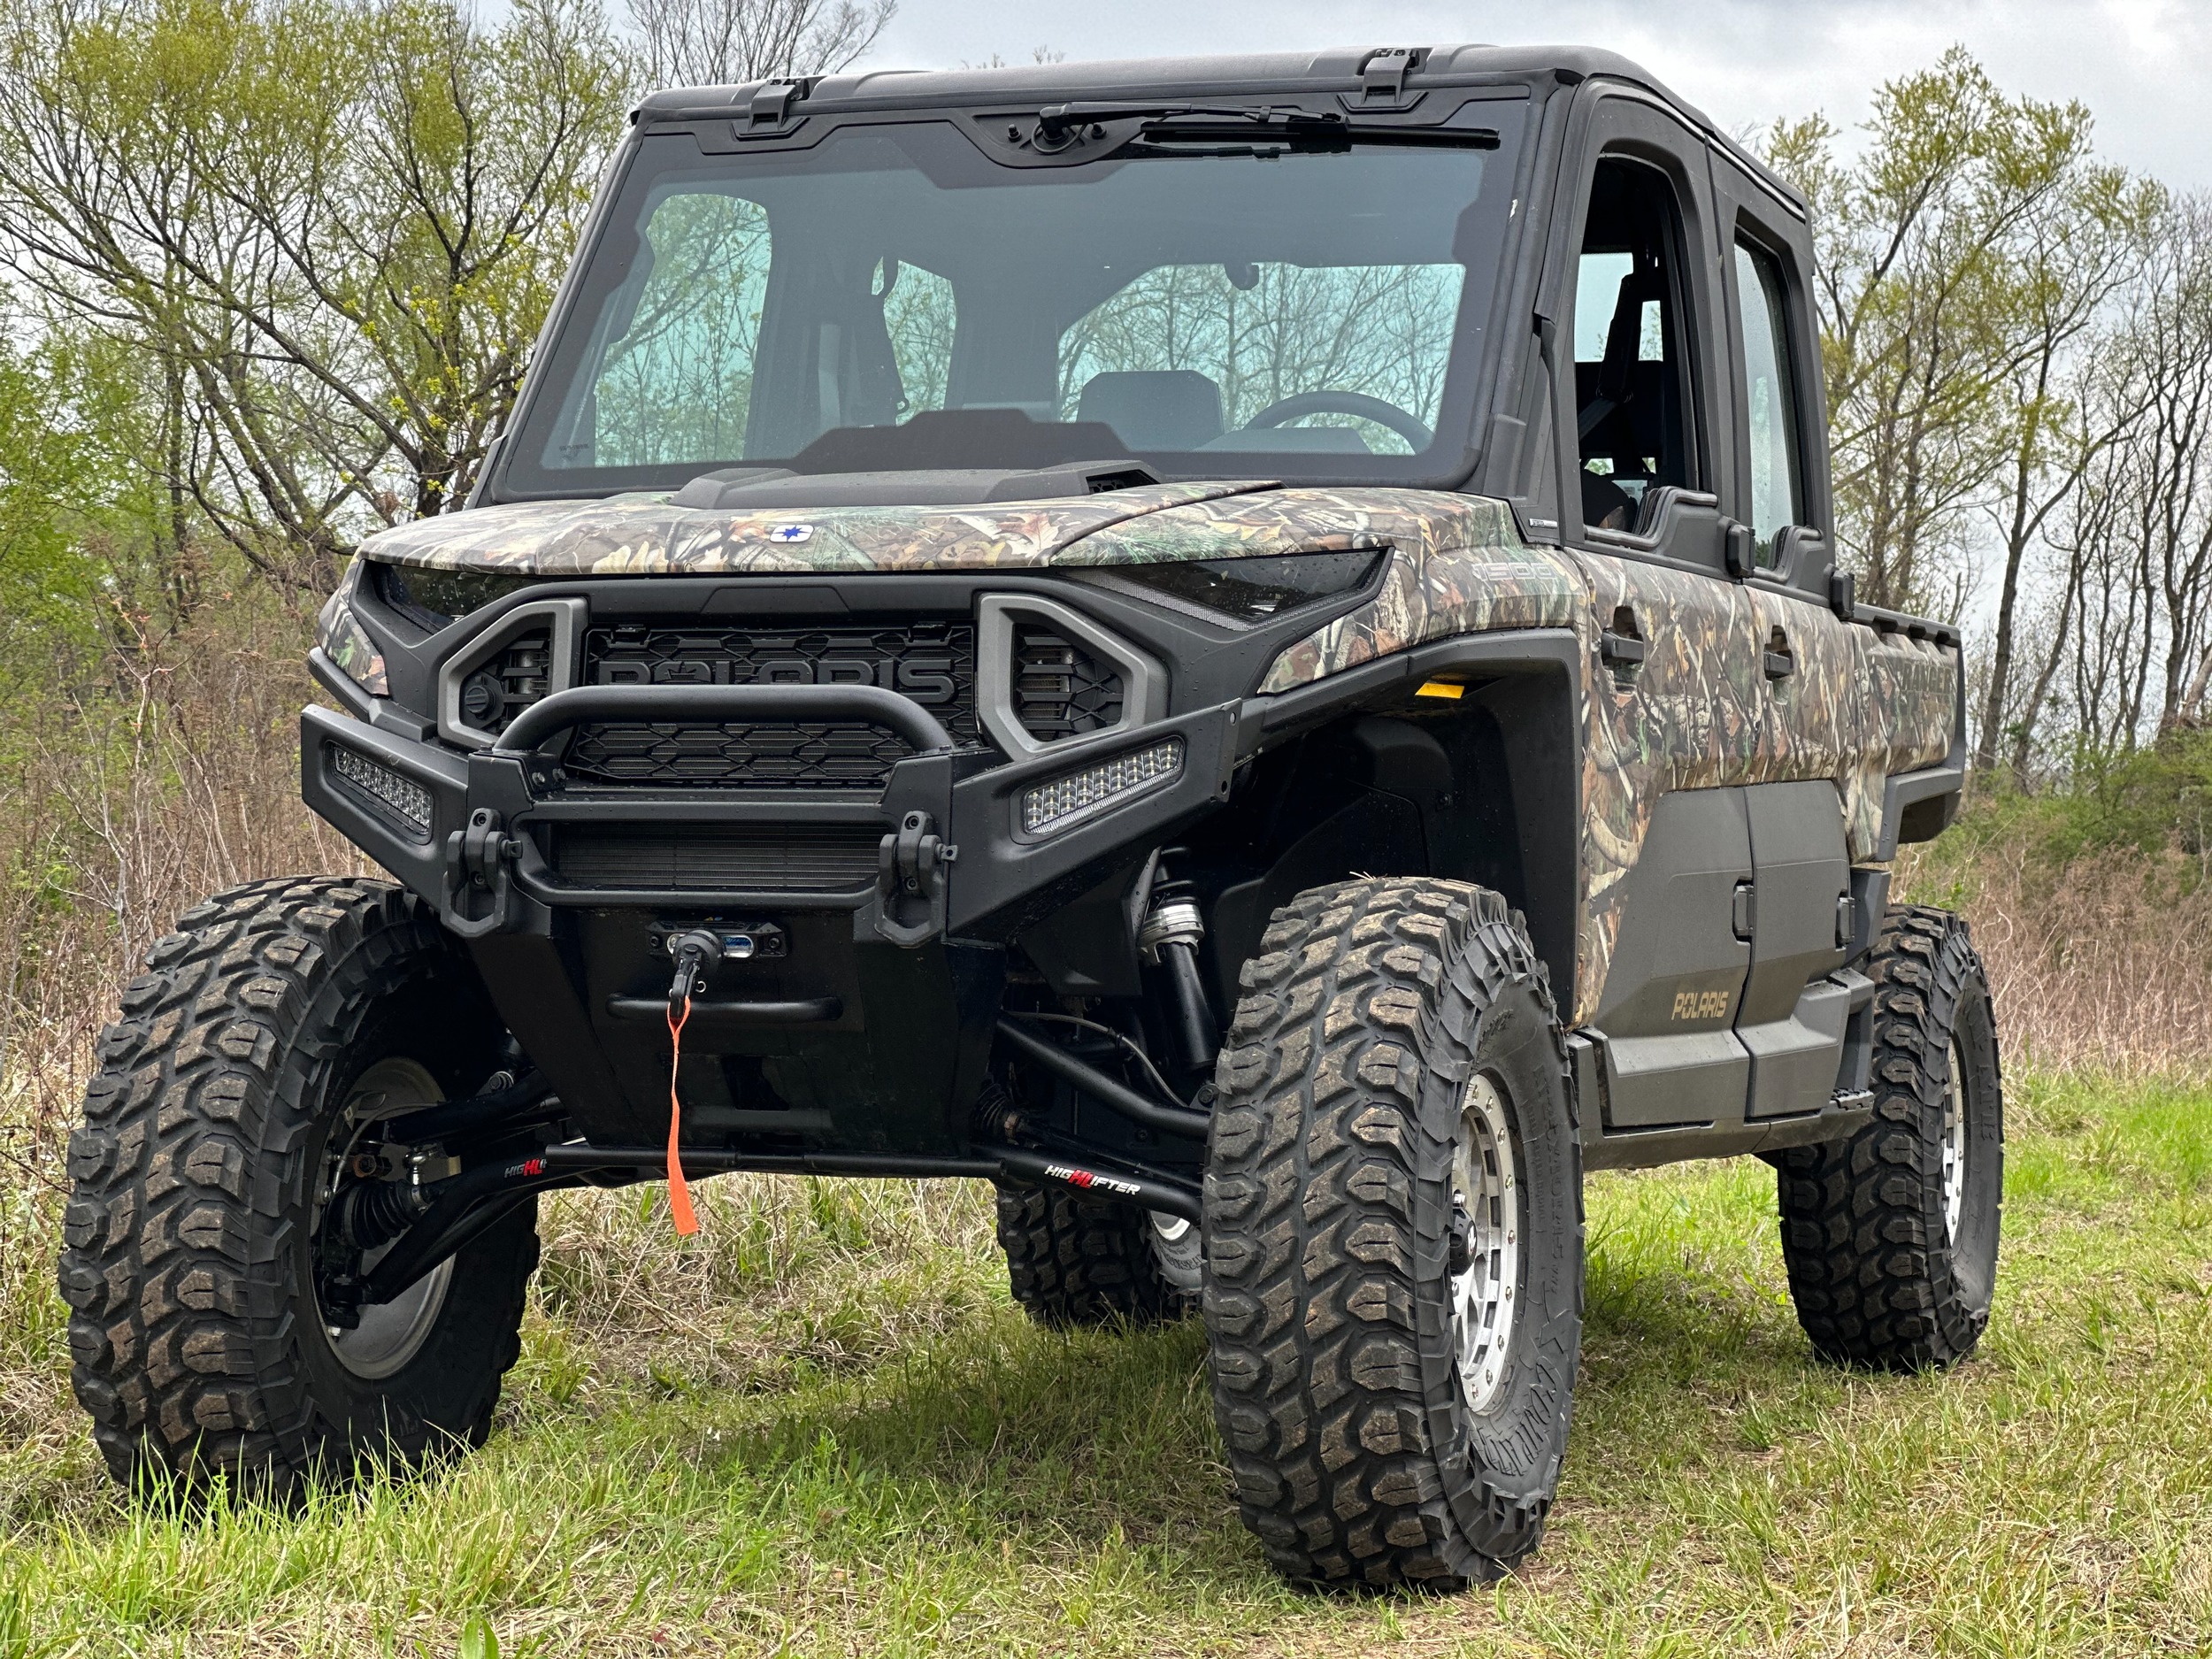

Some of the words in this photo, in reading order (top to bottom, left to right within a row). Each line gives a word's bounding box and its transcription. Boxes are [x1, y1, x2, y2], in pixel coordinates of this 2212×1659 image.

[1471, 562, 1558, 580] 1500
[1902, 662, 1952, 695] RANGER
[1671, 991, 1729, 1020] POLARIS
